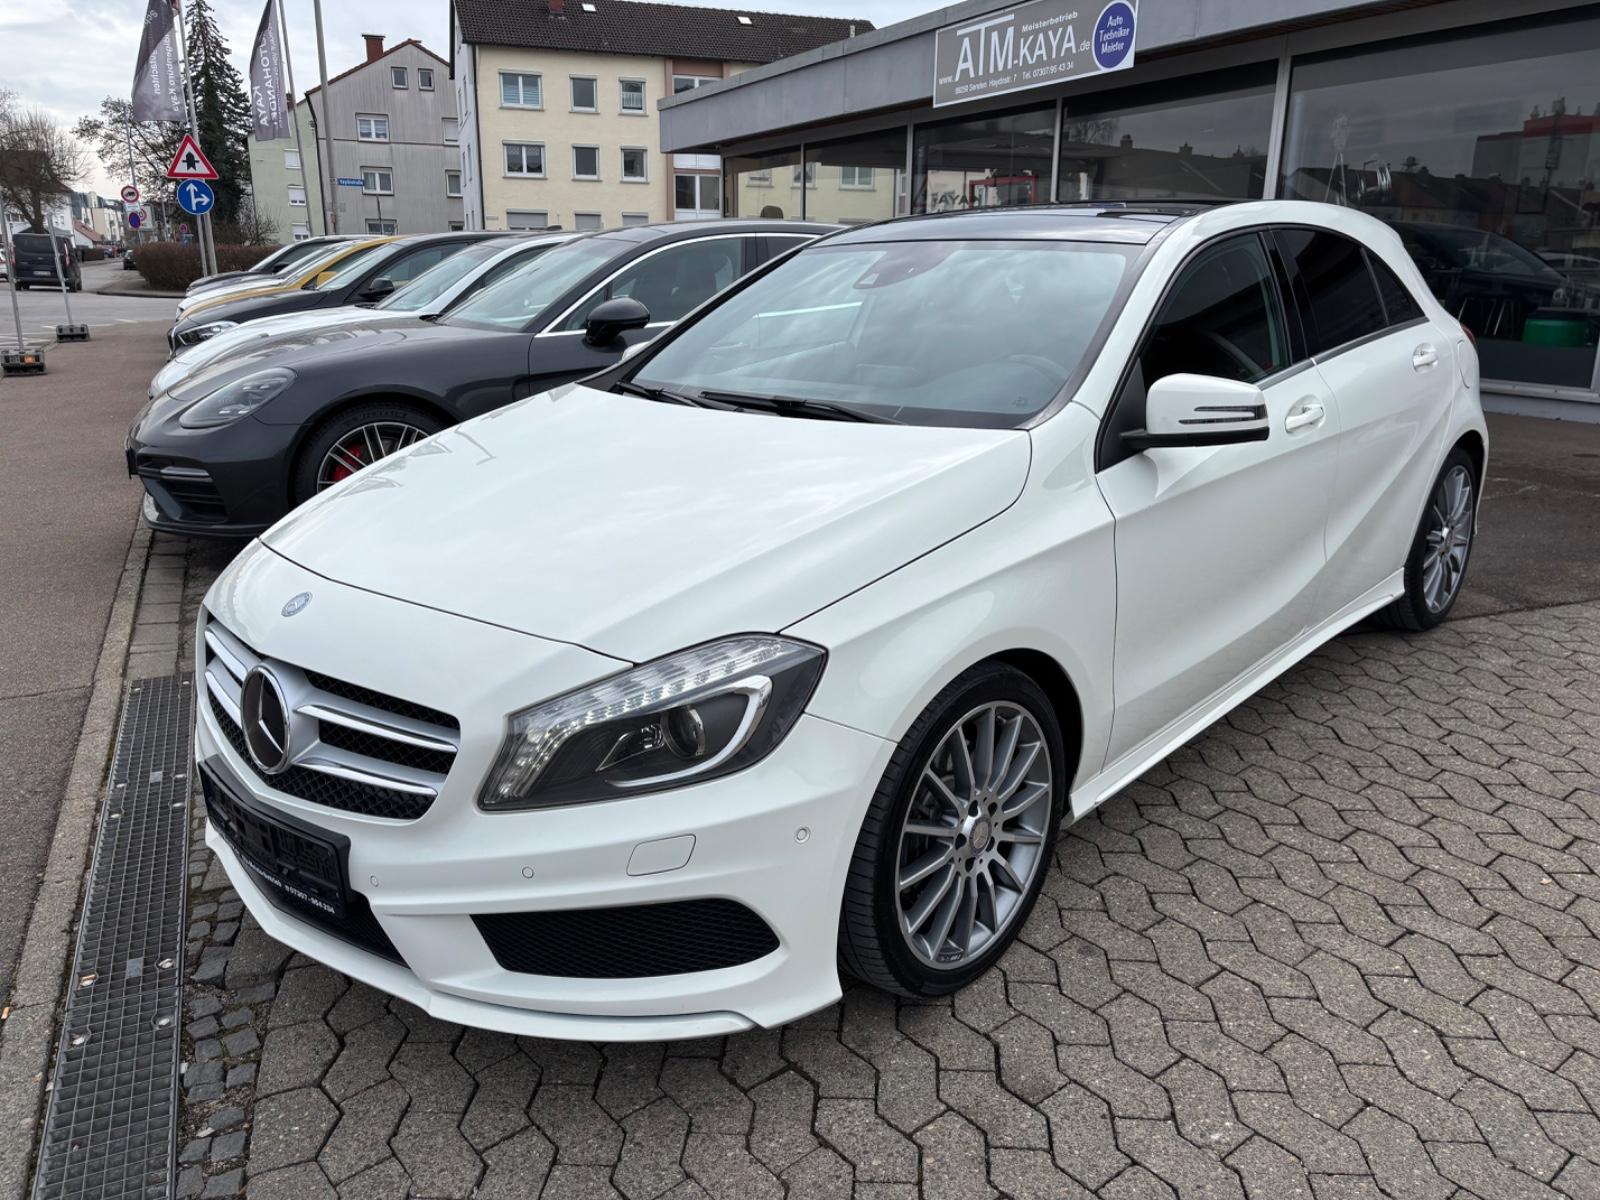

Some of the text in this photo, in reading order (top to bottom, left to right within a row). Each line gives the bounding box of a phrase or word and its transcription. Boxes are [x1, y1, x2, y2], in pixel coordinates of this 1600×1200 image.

[1022, 11, 1078, 33] Meisterbetrieb
[1107, 15, 1123, 28] Auto
[1099, 28, 1130, 42] Techniker
[1101, 42, 1125, 55] Meister
